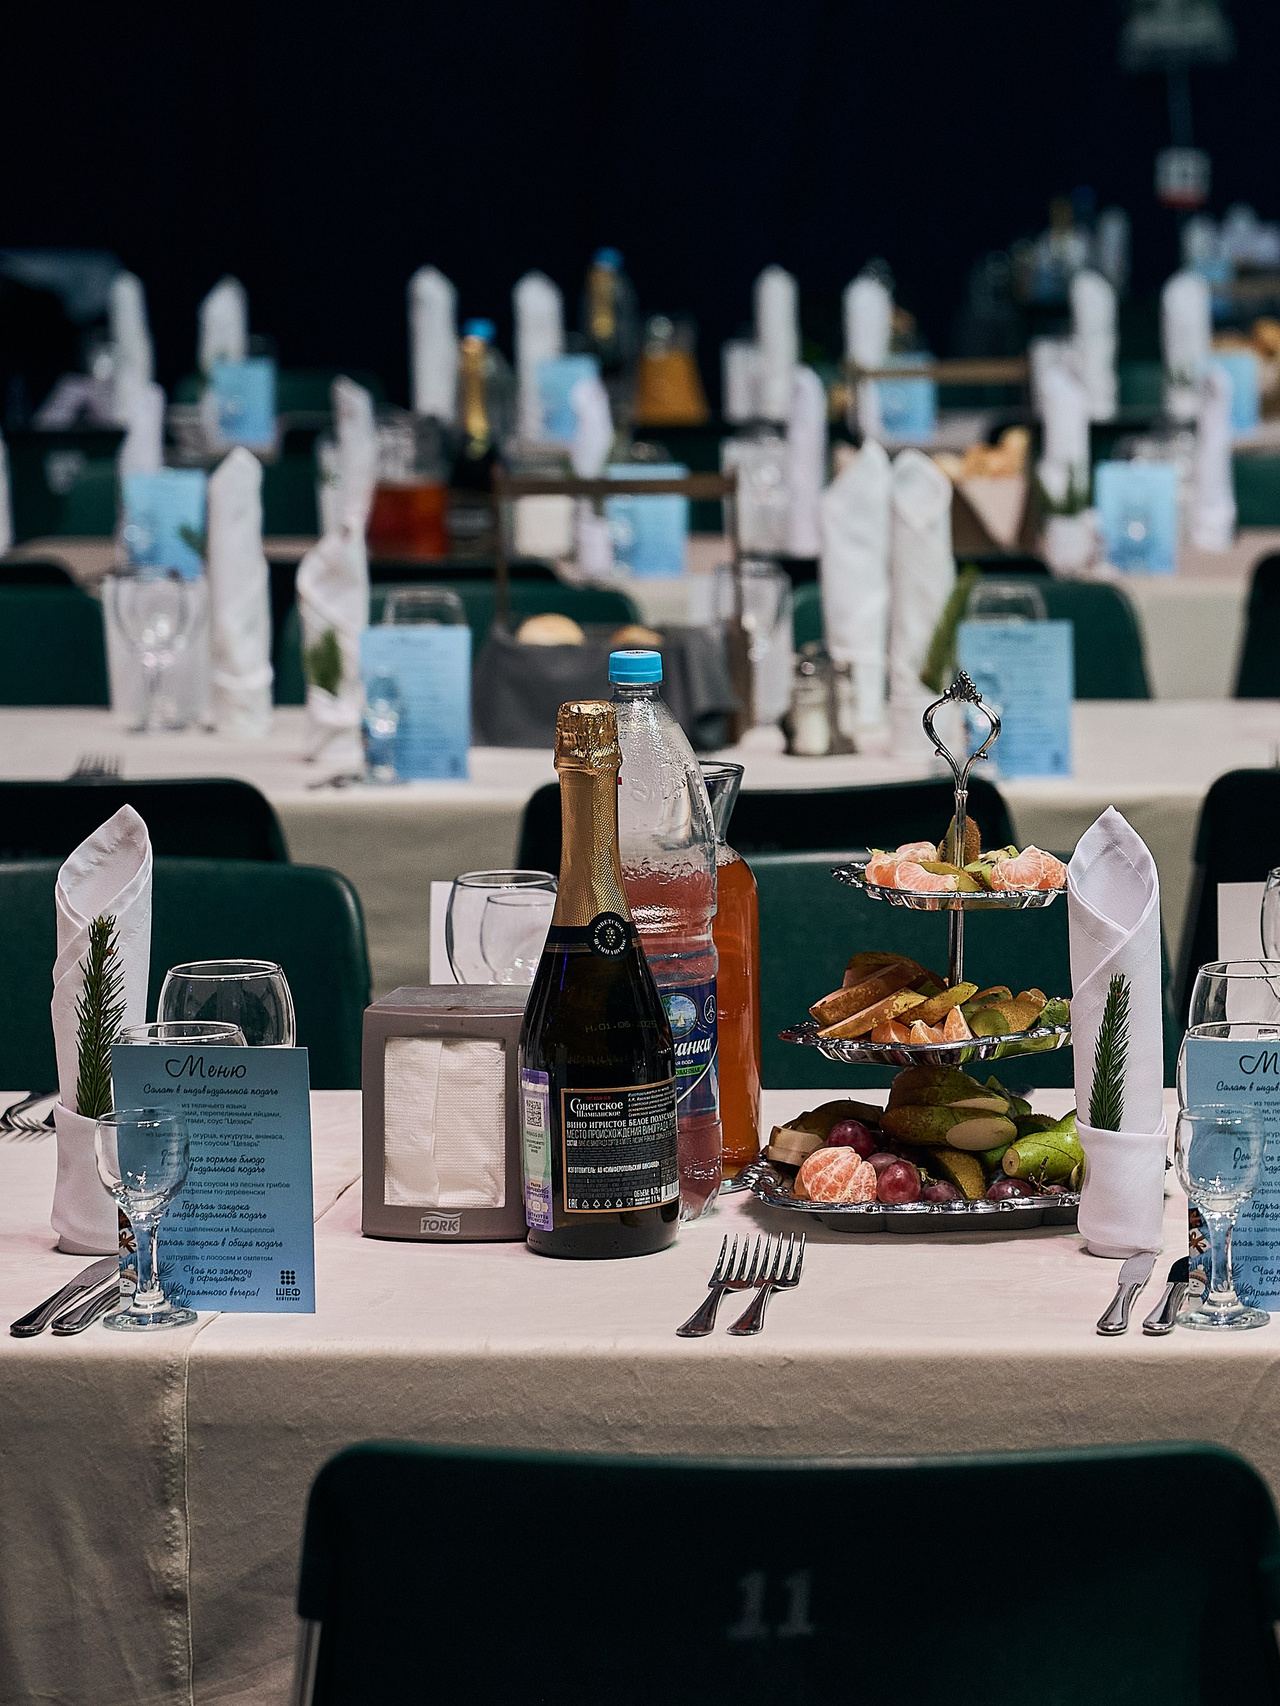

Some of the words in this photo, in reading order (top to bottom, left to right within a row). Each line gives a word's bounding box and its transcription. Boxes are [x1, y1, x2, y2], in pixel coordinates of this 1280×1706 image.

[165, 1055, 247, 1078] Меню
[144, 1084, 174, 1094] Салат
[183, 1085, 249, 1098] индивидуальной
[250, 1089, 279, 1098] подаче
[1216, 1081, 1247, 1092] Салат
[570, 1098, 623, 1113] Советское
[567, 1121, 587, 1129] ВИНО
[589, 1120, 626, 1129] ИГРИСТОЕ
[628, 1117, 649, 1126] БЕЛОЕ
[588, 1126, 641, 1139] ПРОИСХОЖДЕНИЯ
[204, 1139, 229, 1147] соусом
[206, 1156, 237, 1165] горячее
[240, 1155, 265, 1165] блюдо
[238, 1166, 266, 1175] подаче
[182, 1201, 215, 1213] Горячая
[218, 1203, 251, 1213] закуска
[173, 1209, 239, 1222] индивидуальной
[241, 1211, 268, 1221] подаче
[423, 1220, 458, 1231] TORK
[187, 1240, 220, 1250] закуска
[229, 1238, 253, 1250] общей
[256, 1240, 284, 1250] подаче
[183, 1265, 207, 1275] Чай
[1252, 1265, 1275, 1275] Чай
[197, 1274, 246, 1285] официанта
[230, 1287, 260, 1299] вечера!
[276, 1288, 301, 1297] ШЕФ
[727, 1570, 813, 1640] 11
